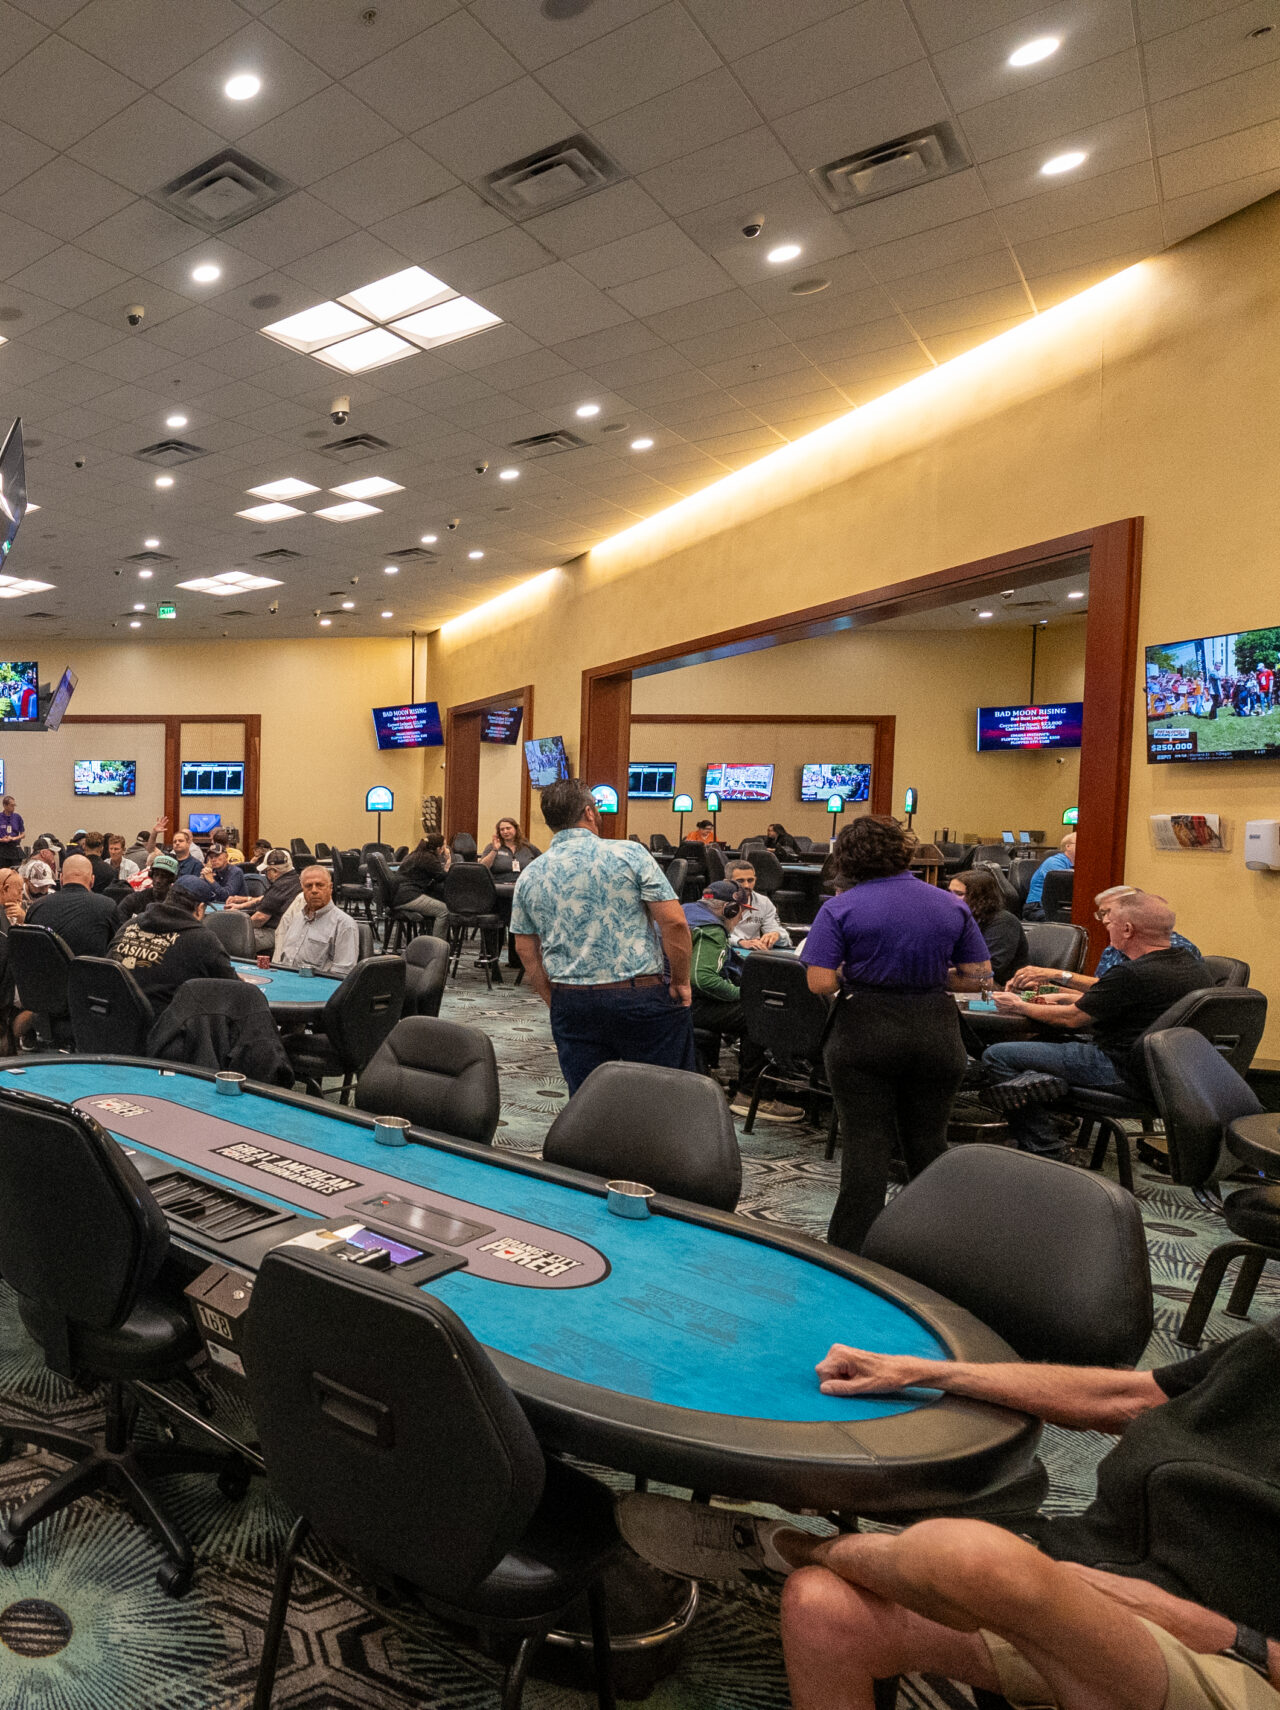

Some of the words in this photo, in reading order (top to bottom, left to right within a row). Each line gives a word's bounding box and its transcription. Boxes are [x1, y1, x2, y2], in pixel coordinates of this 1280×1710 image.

[1151, 743, 1192, 751] $250,000
[117, 943, 158, 961] CASINO
[216, 1148, 256, 1163] POKER
[253, 1161, 338, 1194] TOURNAMENTS
[230, 1143, 281, 1160] GREAT
[274, 1160, 356, 1190] AMERICAN
[500, 1237, 552, 1257] ORANGE
[549, 1254, 582, 1268] CITY
